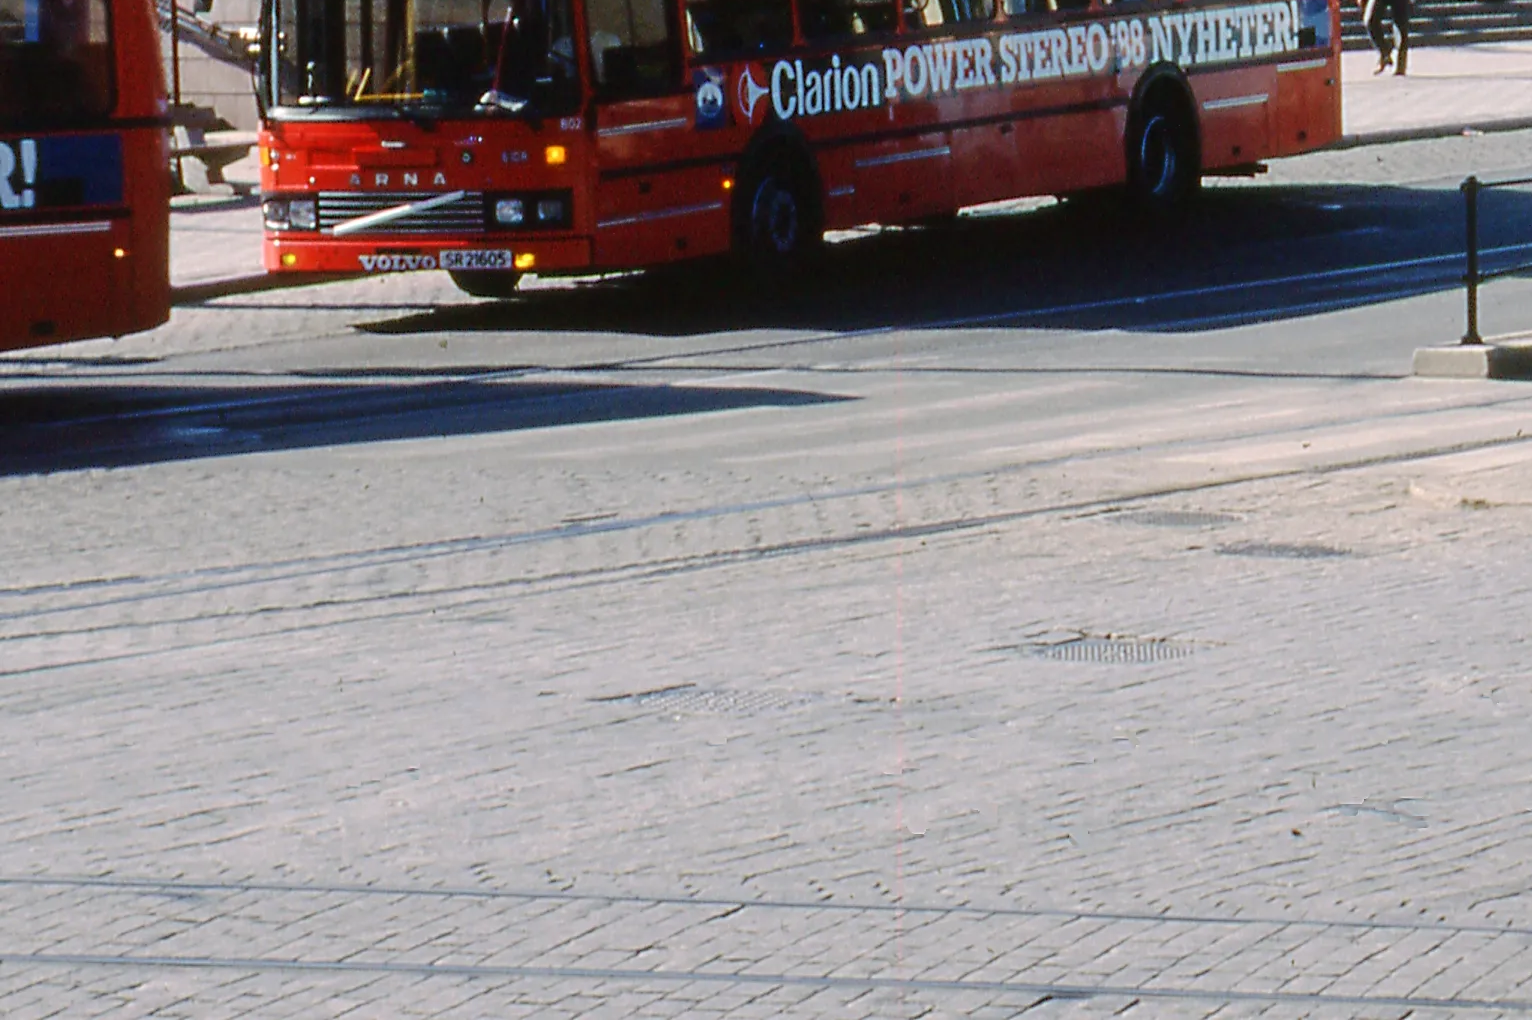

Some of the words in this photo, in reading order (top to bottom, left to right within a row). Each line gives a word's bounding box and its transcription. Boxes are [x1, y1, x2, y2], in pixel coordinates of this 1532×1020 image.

[771, 53, 880, 120] Clarion
[883, 37, 997, 98] POWER
[1000, 21, 1108, 84] STEREO
[1149, 0, 1299, 67] NYHETER!
[350, 172, 446, 186] ARNA
[359, 254, 436, 271] VOLVO
